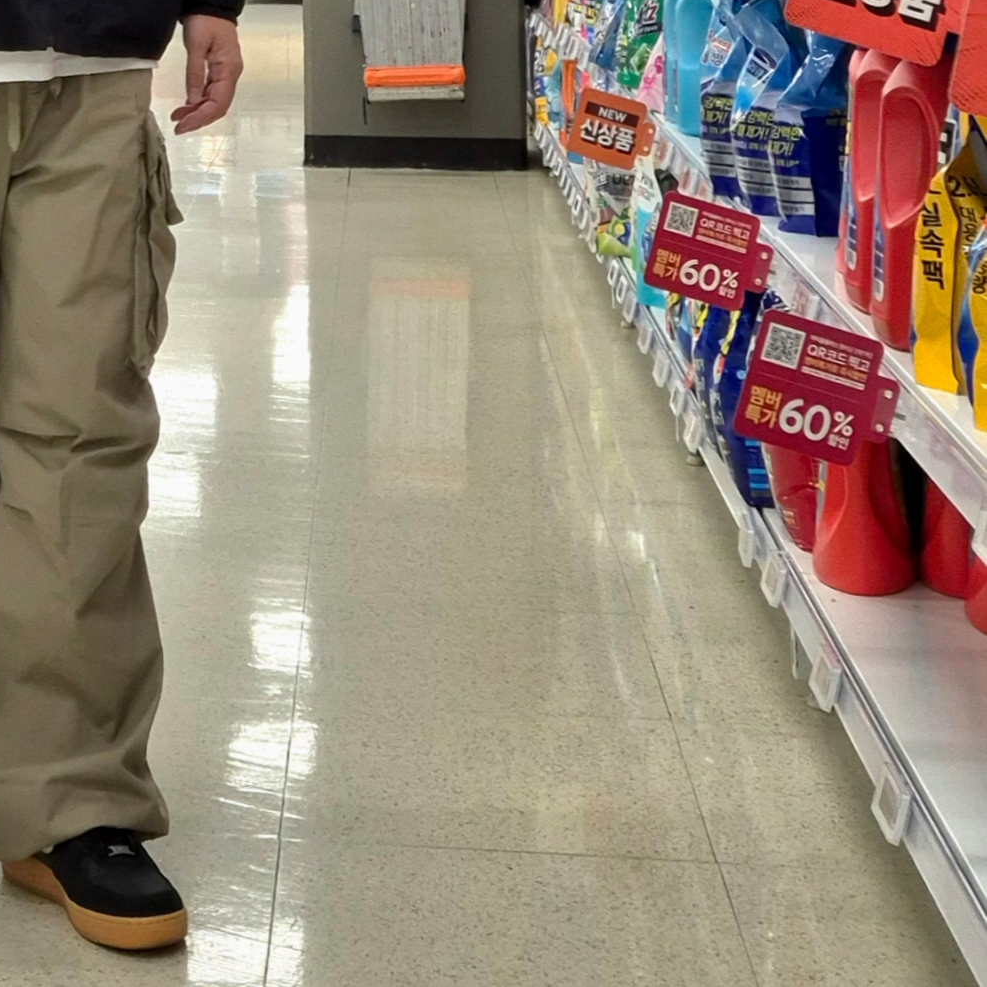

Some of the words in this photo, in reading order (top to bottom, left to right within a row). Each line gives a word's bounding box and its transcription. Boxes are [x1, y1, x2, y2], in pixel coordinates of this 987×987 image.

[598, 107, 627, 123] NEW
[580, 118, 634, 152] 신상품
[700, 217, 732, 234] QR코드
[679, 258, 740, 292] 60%
[807, 344, 846, 365] QR코드
[750, 384, 783, 411] 멤버
[745, 403, 779, 430] 특가
[778, 398, 854, 442] 60%
[827, 433, 851, 451] 할인
